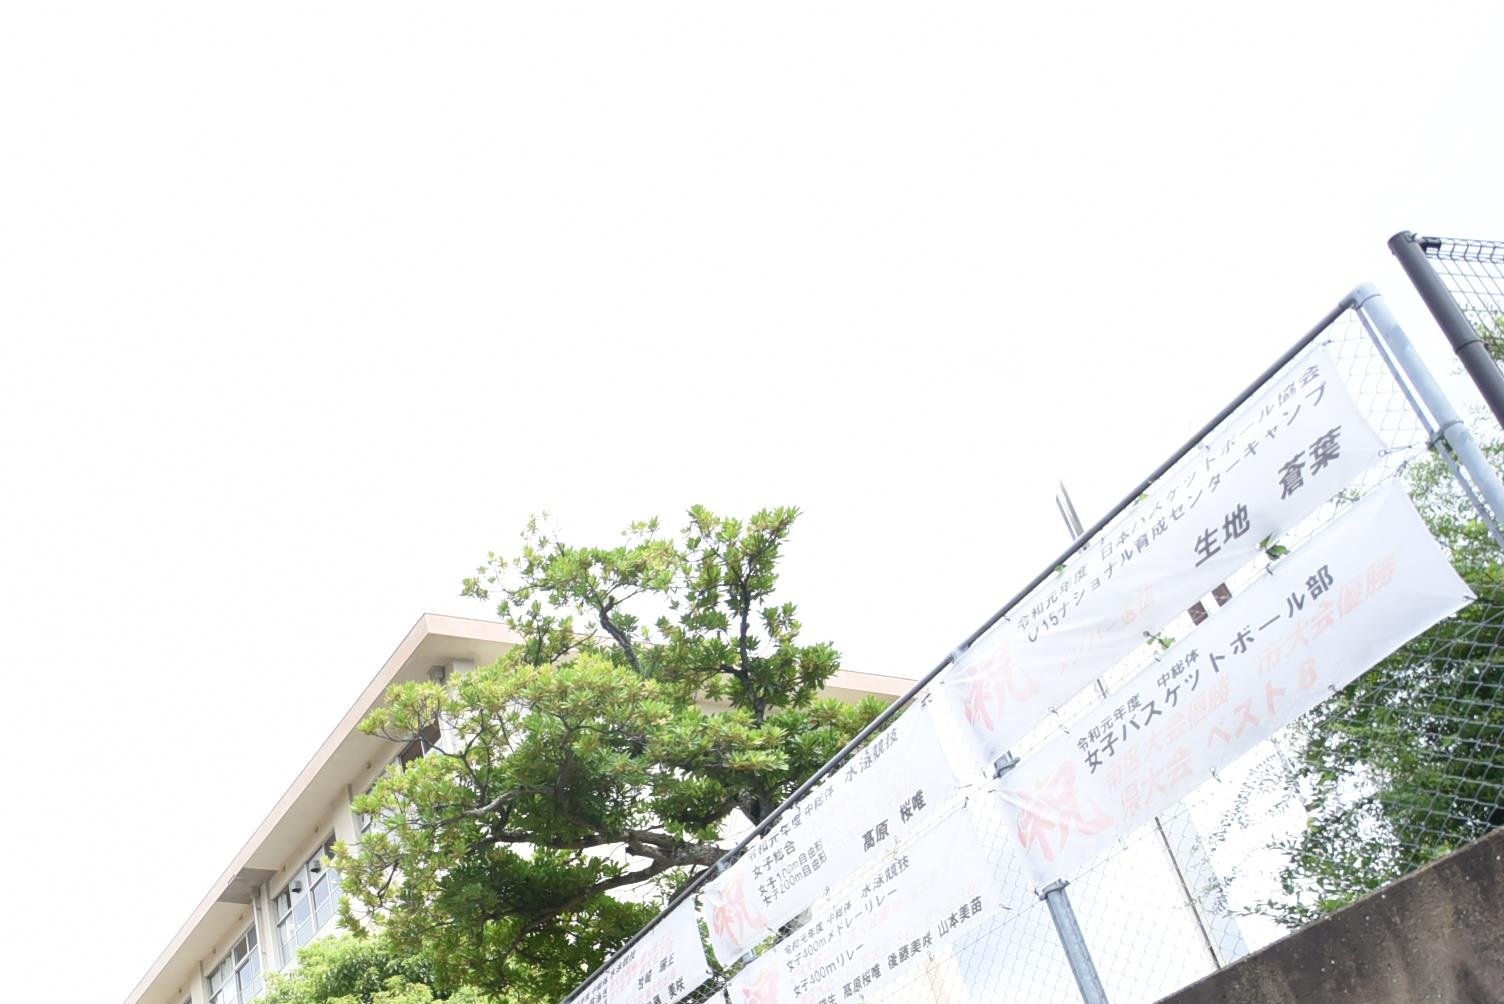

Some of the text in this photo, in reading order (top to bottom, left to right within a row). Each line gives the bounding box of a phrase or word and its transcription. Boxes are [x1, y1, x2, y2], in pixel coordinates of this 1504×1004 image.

[1194, 426, 1341, 567] 生地 蒼葉
[1018, 564, 1087, 630] 令和元年度
[1077, 649, 1199, 751] 令和元年度 中総体
[1083, 565, 1333, 774] 女子バスケットボール部
[752, 841, 795, 879] 女子総合
